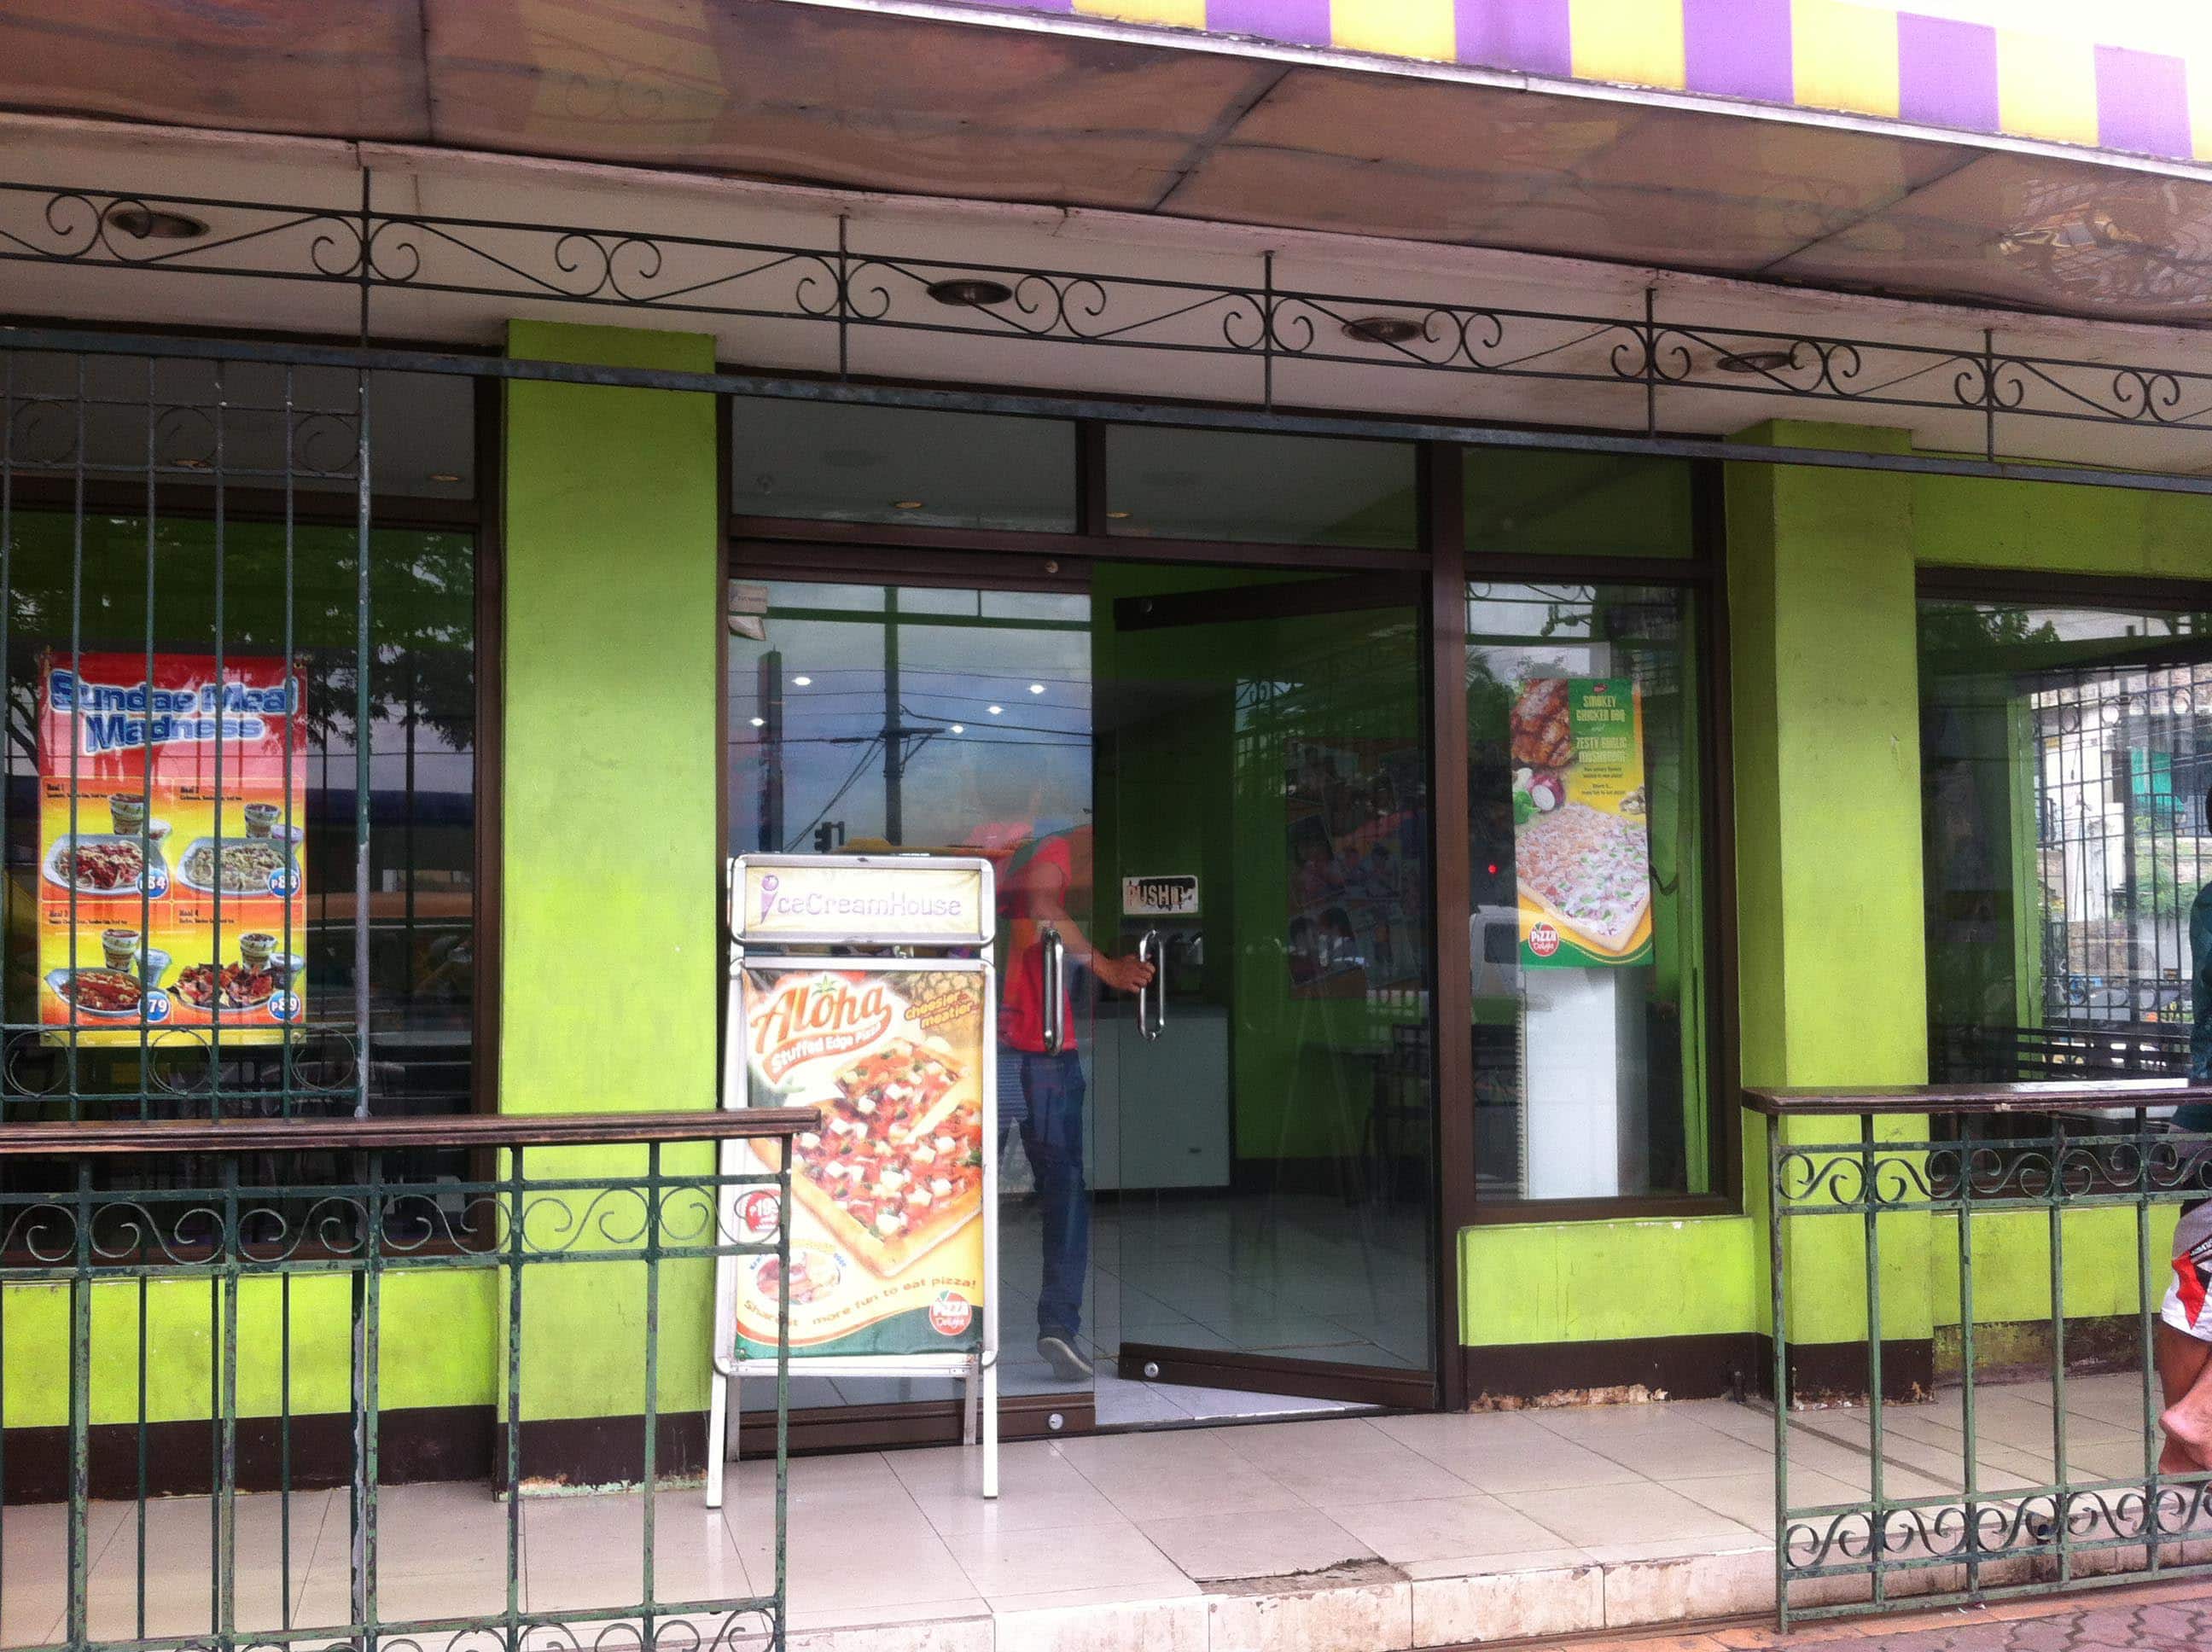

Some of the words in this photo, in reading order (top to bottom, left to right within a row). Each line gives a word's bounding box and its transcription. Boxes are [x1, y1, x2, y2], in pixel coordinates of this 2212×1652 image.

[49, 671, 197, 712] Sundae
[200, 678, 299, 713] Meal
[84, 713, 266, 754] Madness
[751, 984, 885, 1055] Aloha
[771, 1036, 824, 1074] Stuffed
[854, 1294, 879, 1309] fun
[882, 1287, 899, 1297] to
[903, 1278, 926, 1290] eat
[931, 1276, 977, 1289] pizza!
